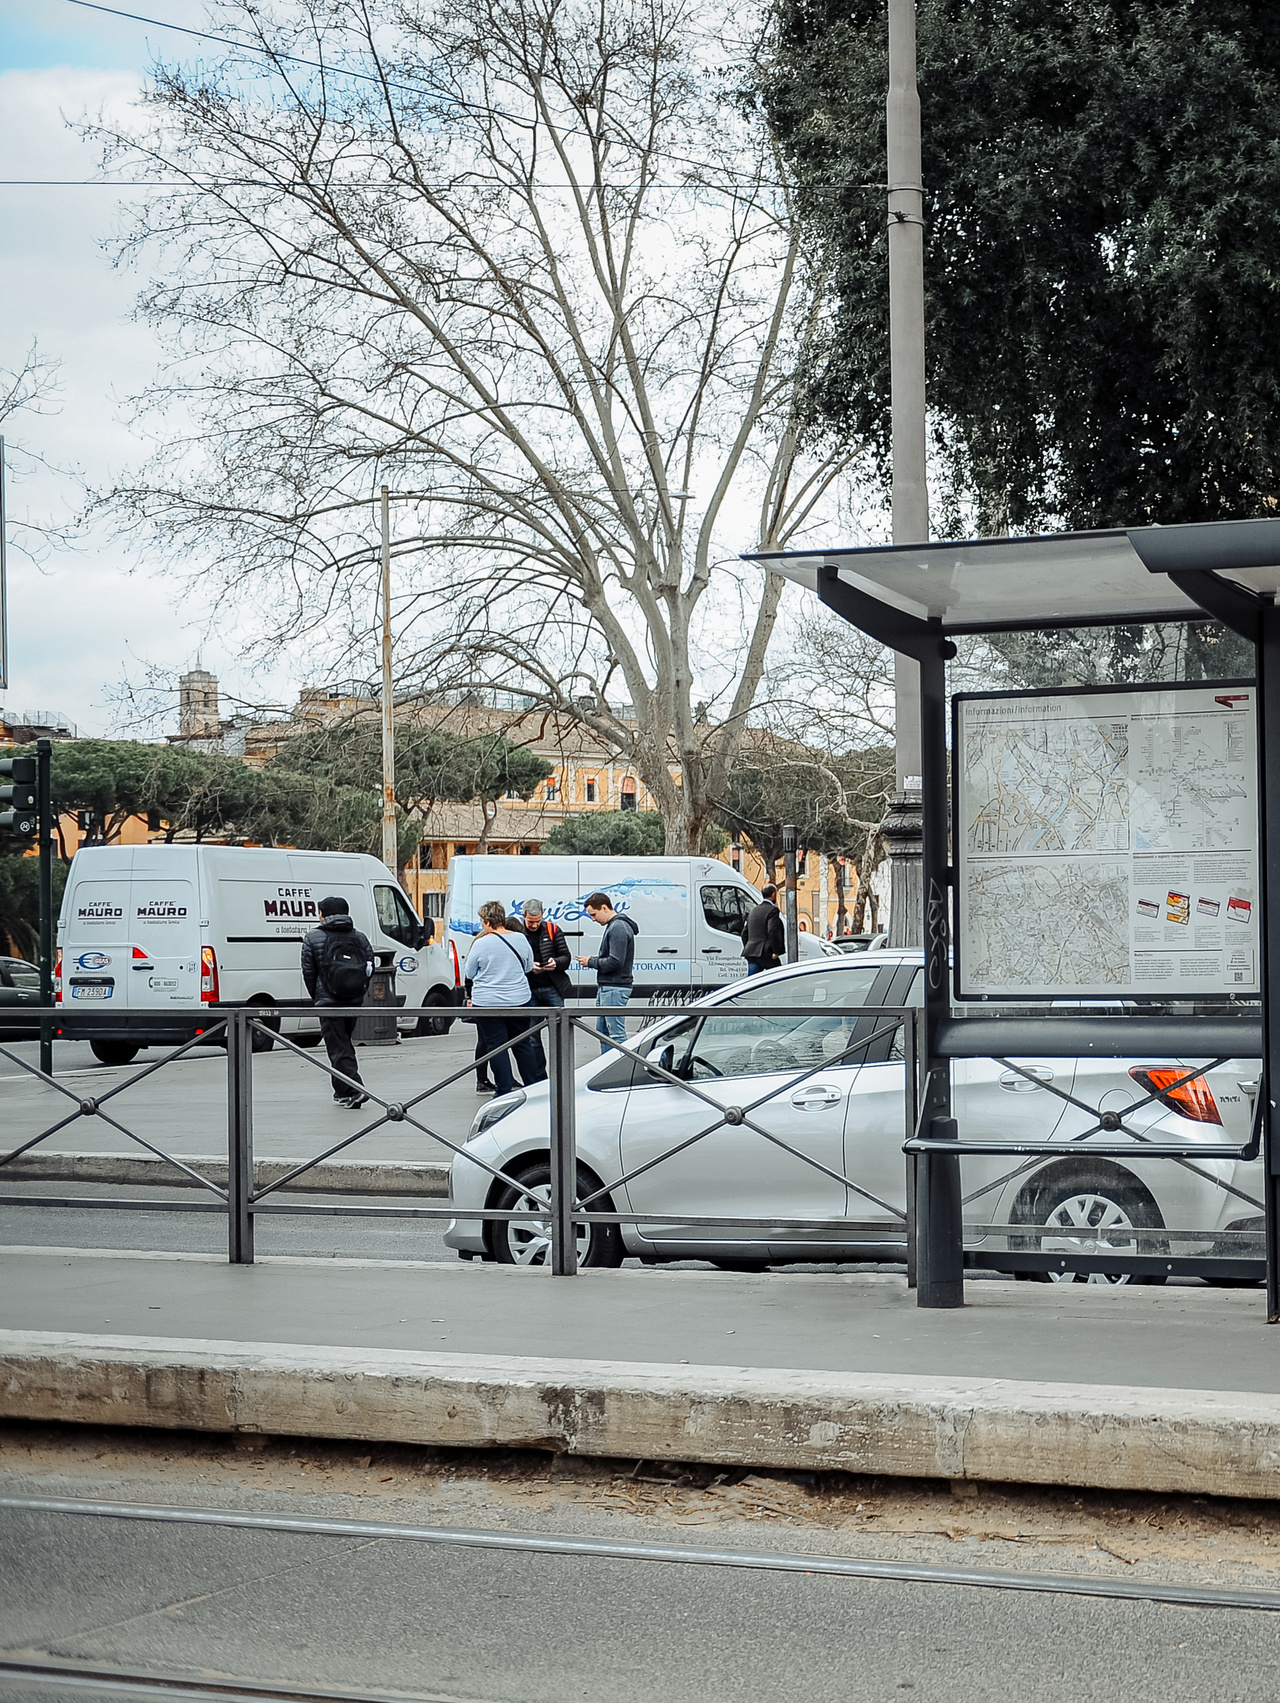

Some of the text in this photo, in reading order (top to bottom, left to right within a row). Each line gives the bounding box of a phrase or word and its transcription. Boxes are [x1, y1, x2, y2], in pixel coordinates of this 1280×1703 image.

[78, 908, 122, 917] MAURO
[137, 907, 187, 916] MAURO
[264, 900, 320, 917] MAUR
